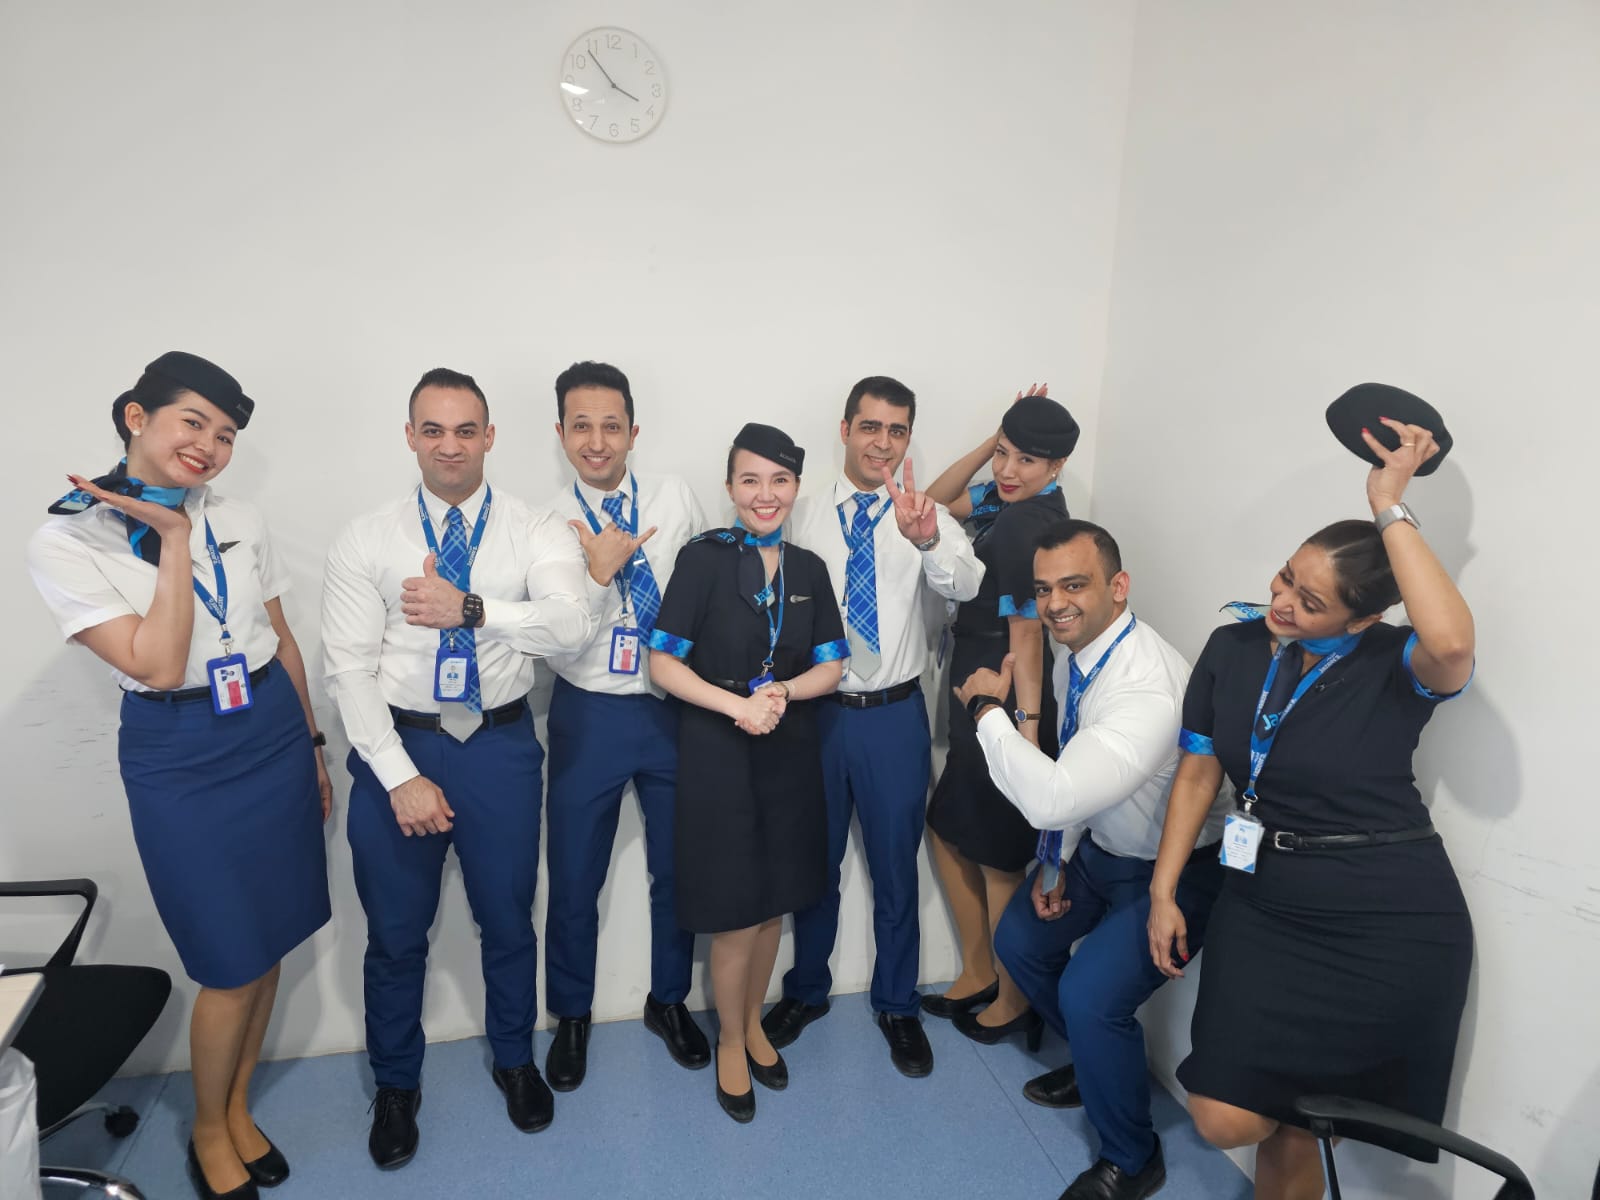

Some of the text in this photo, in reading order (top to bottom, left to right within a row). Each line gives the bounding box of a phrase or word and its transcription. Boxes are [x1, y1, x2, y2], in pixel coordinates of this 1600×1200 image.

[585, 38, 599, 55] 11
[605, 34, 623, 50] 12
[570, 54, 586, 70] 10
[644, 60, 656, 75] 2
[651, 83, 661, 98] 3
[572, 97, 583, 112] 8
[645, 104, 654, 120] 4
[589, 115, 599, 130] 7
[609, 123, 619, 137] 6
[630, 118, 641, 133] 5
[1262, 712, 1280, 731] Ja
